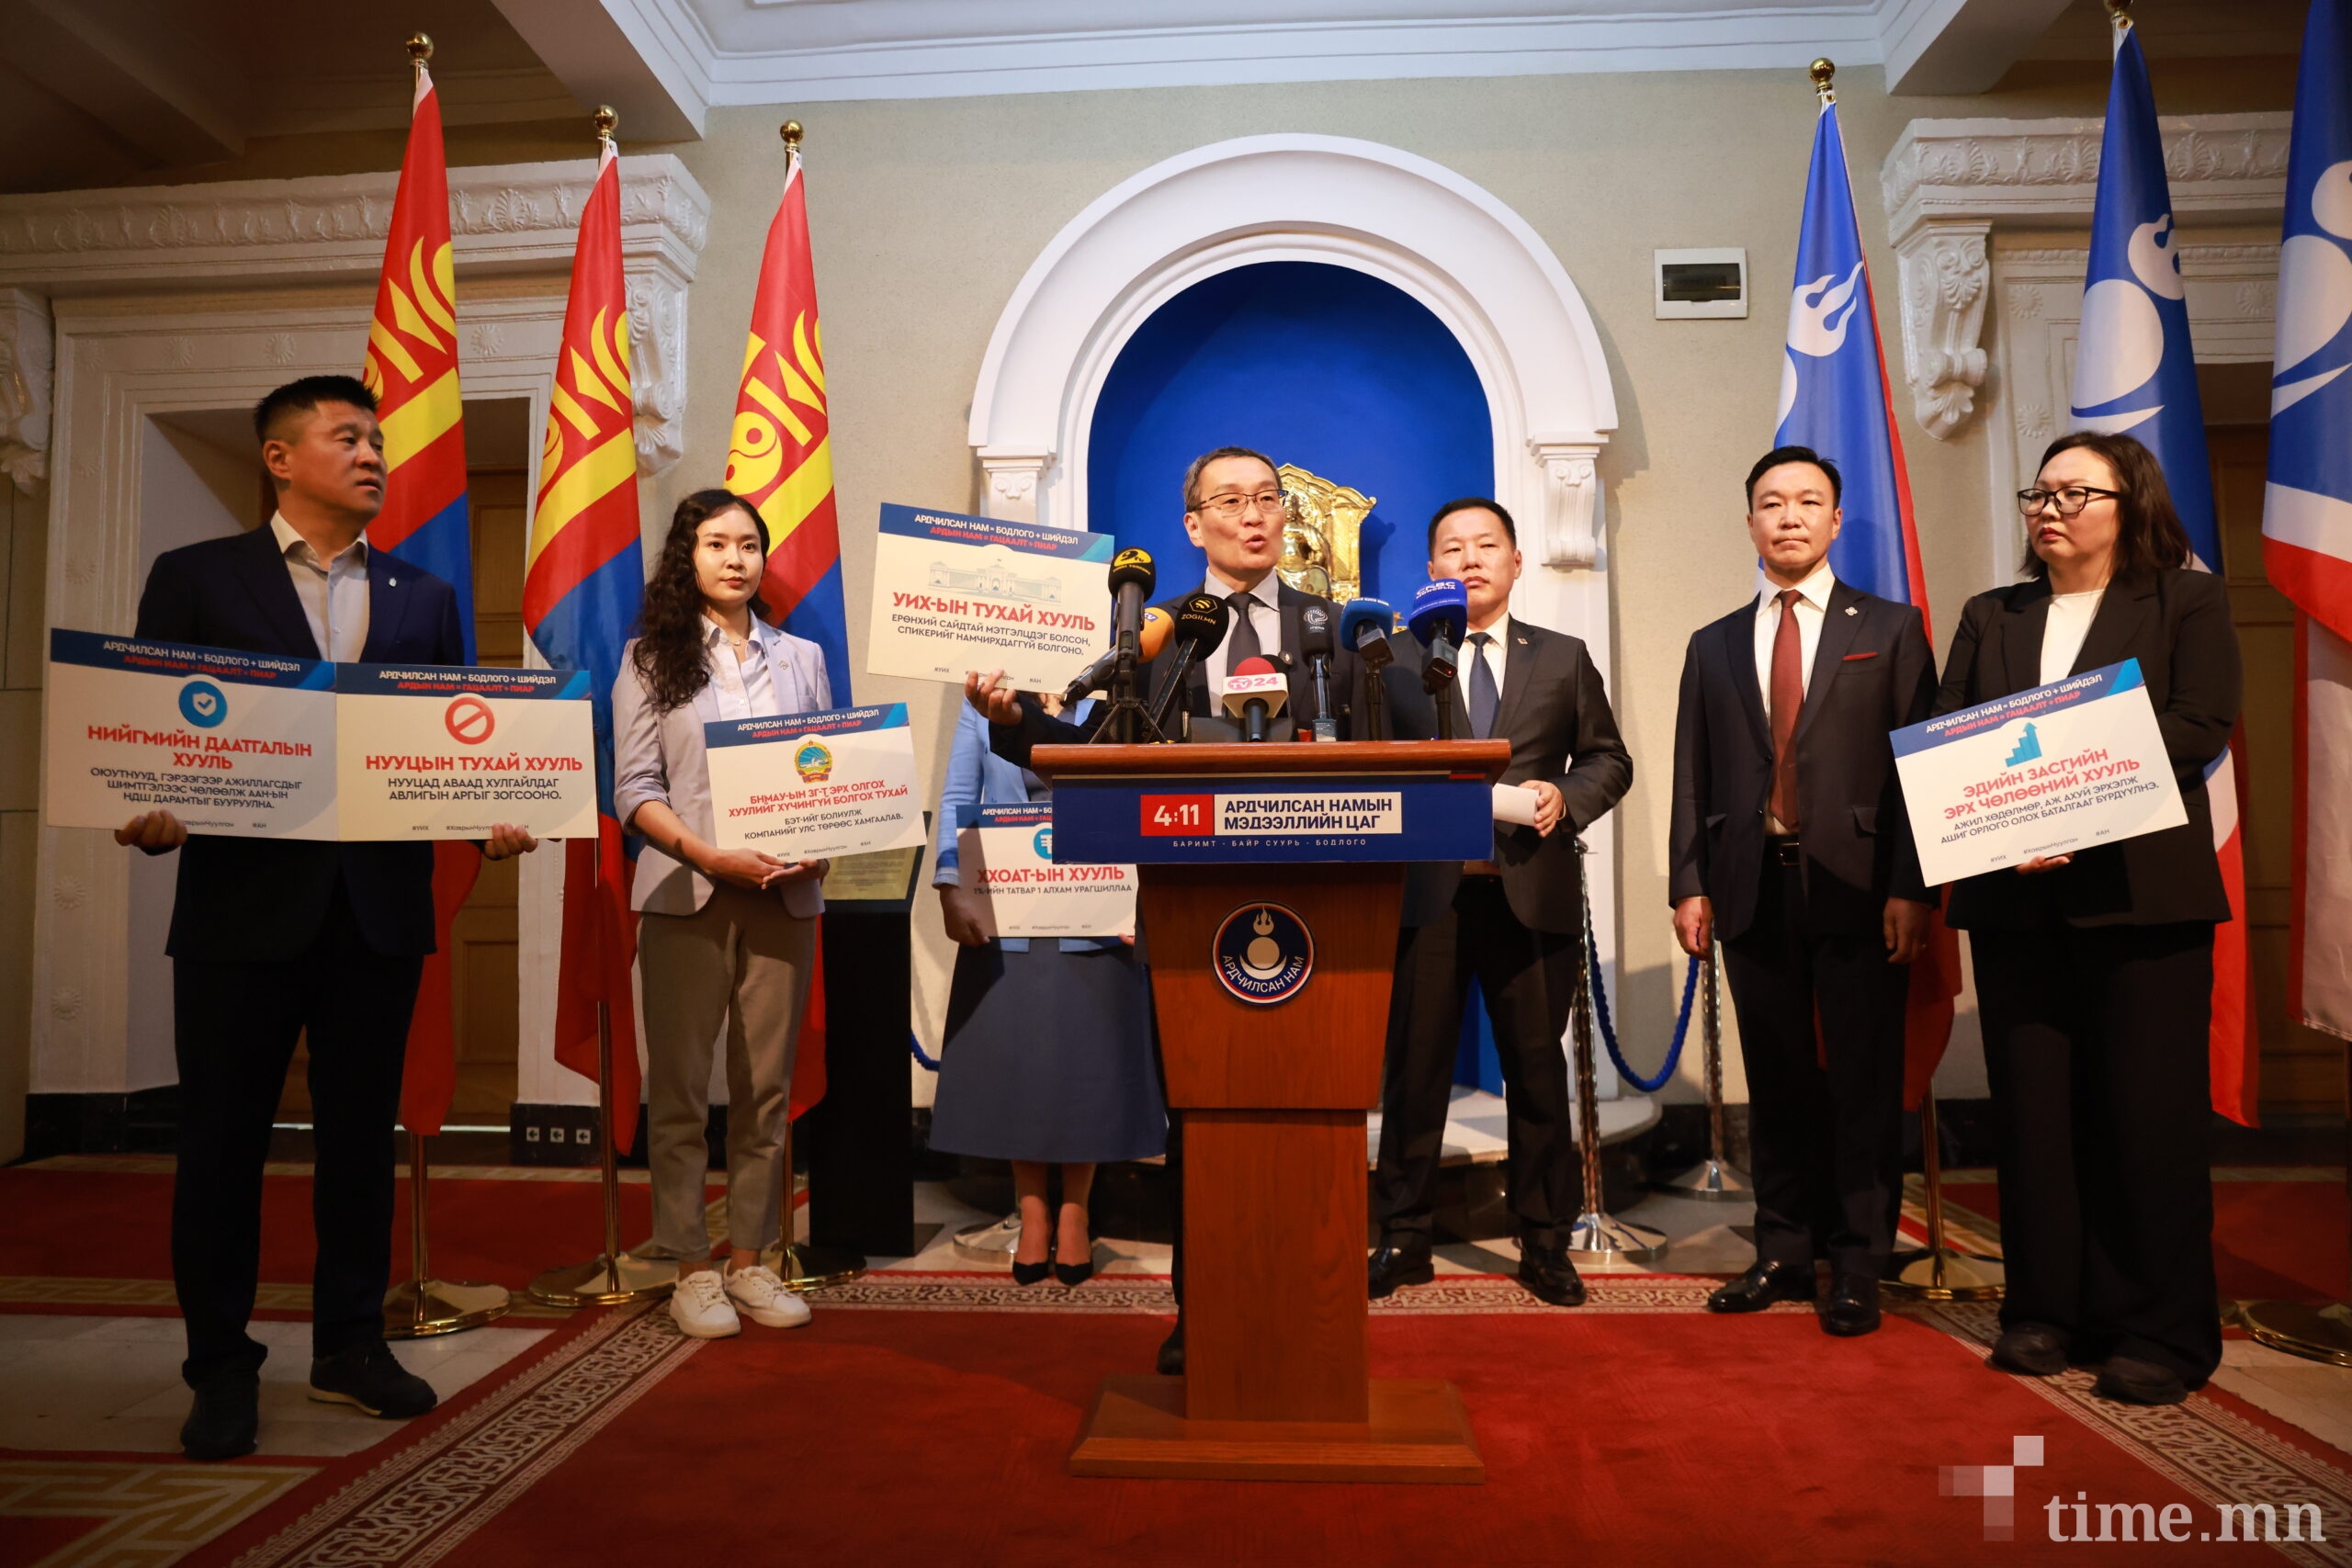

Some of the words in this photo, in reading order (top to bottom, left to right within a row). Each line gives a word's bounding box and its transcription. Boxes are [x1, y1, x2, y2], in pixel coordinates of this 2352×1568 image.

[914, 513, 967, 529] АРДЧИЛСАН
[969, 522, 989, 533] НАМ
[996, 525, 1035, 538] БОДЛОГО
[1042, 531, 1079, 545] ШИЙДЭЛ
[892, 592, 968, 616] УИХ-ЫН
[972, 602, 1033, 625] ТУХАЙ
[1037, 610, 1095, 631] ХУУЛЬ
[892, 614, 937, 627] ЕРӨНХИЙ
[939, 619, 983, 633] САЙДТАЙ
[986, 626, 1048, 641] МЭТГЭЛЦДЭГ
[1049, 633, 1091, 647] БОЛСОН,
[898, 626, 955, 640] СПИКЕРИЙГ
[956, 632, 1035, 649] НАМЧИРХДАГГҮЙ
[1037, 642, 1084, 656] БОЛГОНО.
[103, 640, 169, 657] АРДЧИЛСАН
[172, 650, 197, 661] НАМ
[204, 653, 249, 667] БОДЛОГО
[258, 659, 300, 671] ШИЙДЭЛ
[379, 671, 437, 682] АРДЧИЛСАН
[439, 672, 461, 682] НАМ
[468, 673, 509, 683] БОДЛОГО
[517, 675, 557, 685] ШИЙДЭЛ
[1926, 711, 1980, 734] АРДЧИЛСАН
[1981, 703, 2003, 716] НАМ
[2008, 689, 2052, 708] БОДЛОГО
[2059, 673, 2103, 694] ШИЙДЭЛ
[737, 719, 783, 731] АРДЧИЛСАН
[784, 718, 802, 727] НАМ
[807, 715, 841, 724] БОДЛОГО
[847, 708, 879, 720] ШИЙДЭЛ
[87, 724, 200, 749] НИЙГМИЙН
[205, 736, 312, 757] ДААТГАЛЫН
[173, 751, 234, 770] ХУУЛЬ
[366, 755, 454, 773] НУУЦЫН
[458, 752, 520, 771] ТУХАЙ
[525, 757, 582, 772] ХУУЛЬ
[90, 767, 158, 783] ОЮУТНУУД,
[161, 773, 222, 785] ГЭРЭЭГЭЭР
[388, 778, 440, 788] НУУЦАД
[443, 778, 483, 788] АВААД
[485, 775, 559, 789] ХУЛГАЙЛДАГ
[1962, 770, 2025, 798] ЭДИЙН
[2027, 748, 2109, 781] ЗАСГИЙН
[107, 780, 187, 794] ШИМТГЭЛЭЭС
[189, 784, 245, 797] ЧӨЛӨӨЛЖ
[248, 789, 288, 799] ААН-ЫН
[123, 792, 151, 803] НДШ
[153, 794, 211, 806] ДАРАМТЫГ
[213, 797, 275, 809] БУУРУУЛНА.
[389, 790, 449, 800] АВЛИГЫН
[452, 790, 491, 800] АРГЫГ
[492, 790, 562, 800] ЗОГСООНО.
[750, 790, 807, 805] БНМАУ-ЫН
[830, 784, 849, 795] ЭРХ
[851, 780, 886, 793] ОЛГОХ
[1943, 802, 1977, 820] ЭРХ
[1977, 770, 2080, 809] ЧӨЛӨӨНИЙ
[2083, 758, 2141, 784] ХУУЛЬ
[729, 802, 776, 818] ХУУЛИЙГ
[777, 795, 831, 812] ХҮЧИНГҮЙ
[833, 793, 874, 806] БОЛГОХ
[875, 784, 908, 799] ТУХАЙ
[981, 807, 1022, 816] АРДЧИЛСАН
[1023, 807, 1038, 815] НАМ
[1225, 799, 1325, 814] АРДЧИЛСАН
[1329, 798, 1393, 812] НАМЫН
[1953, 816, 1984, 831] АЖИЛ
[1984, 800, 2043, 822] ХӨДӨЛМӨР,
[2045, 795, 2062, 807] АЖ
[2064, 785, 2091, 803] АХУЙ
[2093, 775, 2139, 795] ЭРХЭЛЖ
[785, 813, 820, 826] БЭТ-ИЙГ
[820, 807, 863, 820] БОЛИУЛЖ
[1153, 804, 1200, 827] 4:11
[1224, 813, 1342, 831] МЭДЭЭЛЛИЙН
[1346, 815, 1381, 831] ЦАГ
[1940, 829, 1969, 845] АШИГ
[1970, 820, 2009, 837] ОРЛОГО
[2011, 813, 2040, 826] ОЛОХ
[2041, 798, 2094, 818] БАТАЛГААГ
[2096, 781, 2160, 805] БҮРДҮҮЛНЭ.
[744, 826, 797, 840] КОМПАНИЙГ
[799, 824, 816, 834] УЛС
[817, 819, 853, 831] ТӨРӨӨС
[854, 813, 904, 826] ХАМГААЛАВ.
[1172, 840, 1216, 848] БАРИМТ
[1231, 839, 1260, 847] БАЙР
[977, 867, 1064, 885] ХХОАТ-ЫН
[1069, 866, 1125, 882] ХУУЛЬ
[1006, 886, 1036, 895] ТАТВАР
[1043, 886, 1072, 894] АЛХАМ
[1073, 885, 1132, 894] УРАГШИЛЛАА
[1222, 955, 1285, 993] АРДЧИЛСАН
[1283, 955, 1305, 984] НАМ
